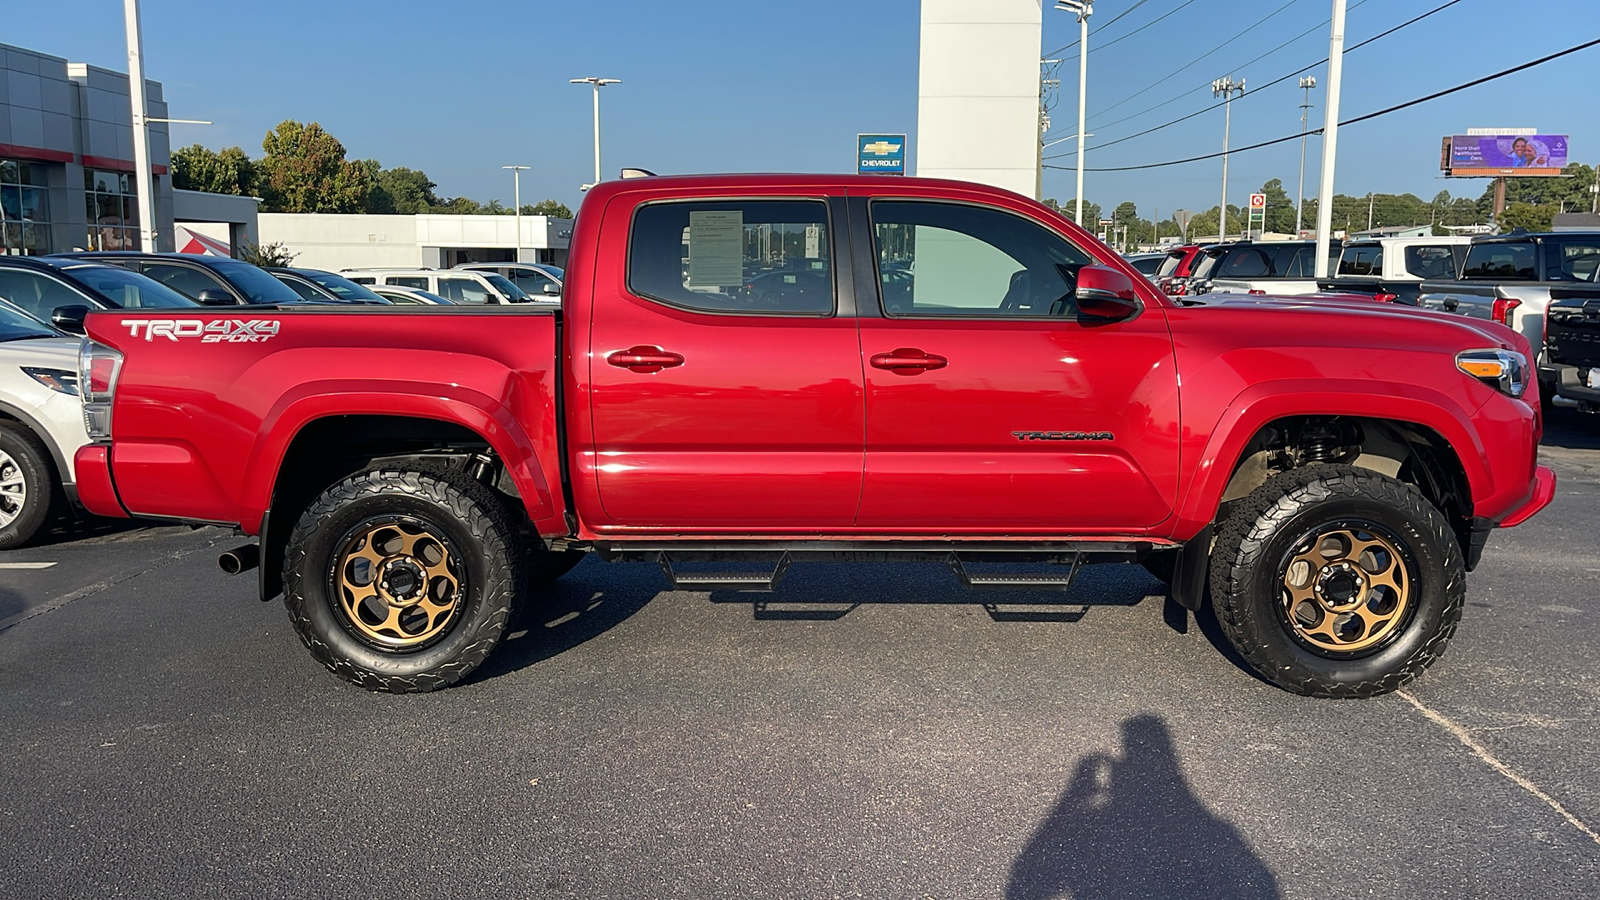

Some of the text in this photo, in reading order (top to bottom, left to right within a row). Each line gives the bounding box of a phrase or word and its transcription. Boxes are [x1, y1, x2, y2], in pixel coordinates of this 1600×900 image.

[121, 319, 204, 342] TRD
[201, 334, 276, 343] SPORT
[1011, 430, 1114, 441] TACOMA
